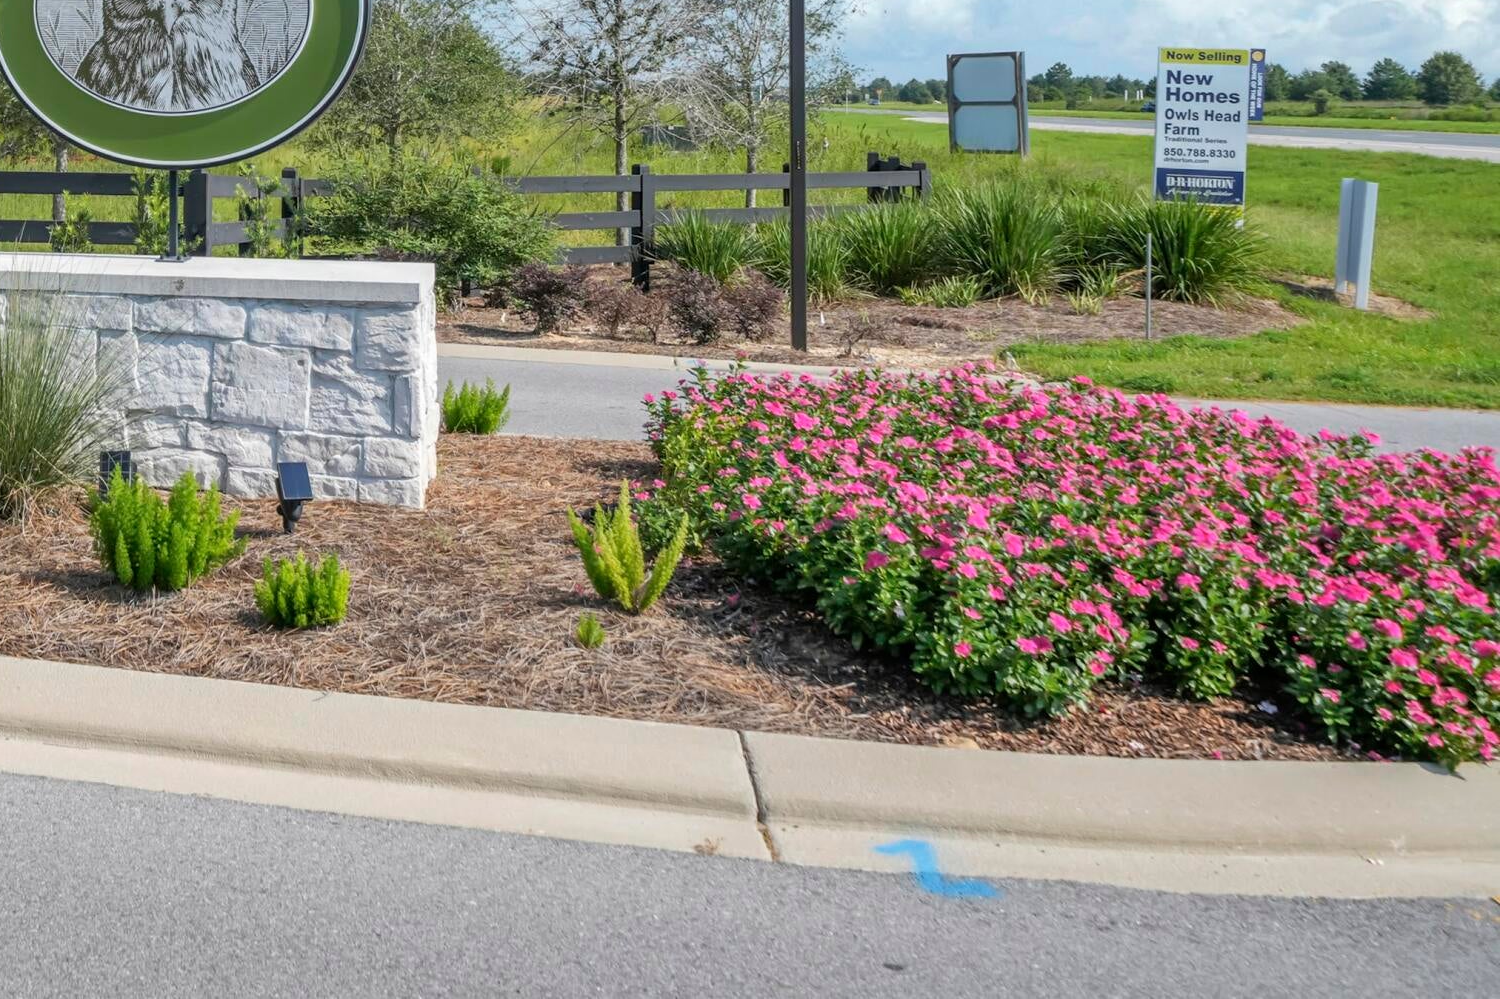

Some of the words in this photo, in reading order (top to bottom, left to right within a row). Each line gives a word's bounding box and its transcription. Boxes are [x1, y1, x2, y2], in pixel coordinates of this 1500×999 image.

[1166, 51, 1194, 61] Now
[1198, 52, 1242, 64] Selling
[1166, 70, 1214, 86] New
[1165, 87, 1241, 104] Homes
[1164, 108, 1199, 121] Owls
[1204, 109, 1241, 123] Head
[1164, 123, 1200, 136] Farm
[1164, 136, 1202, 144] Traditional
[1204, 137, 1228, 145] Series
[1163, 148, 1236, 159] 850.788.8330
